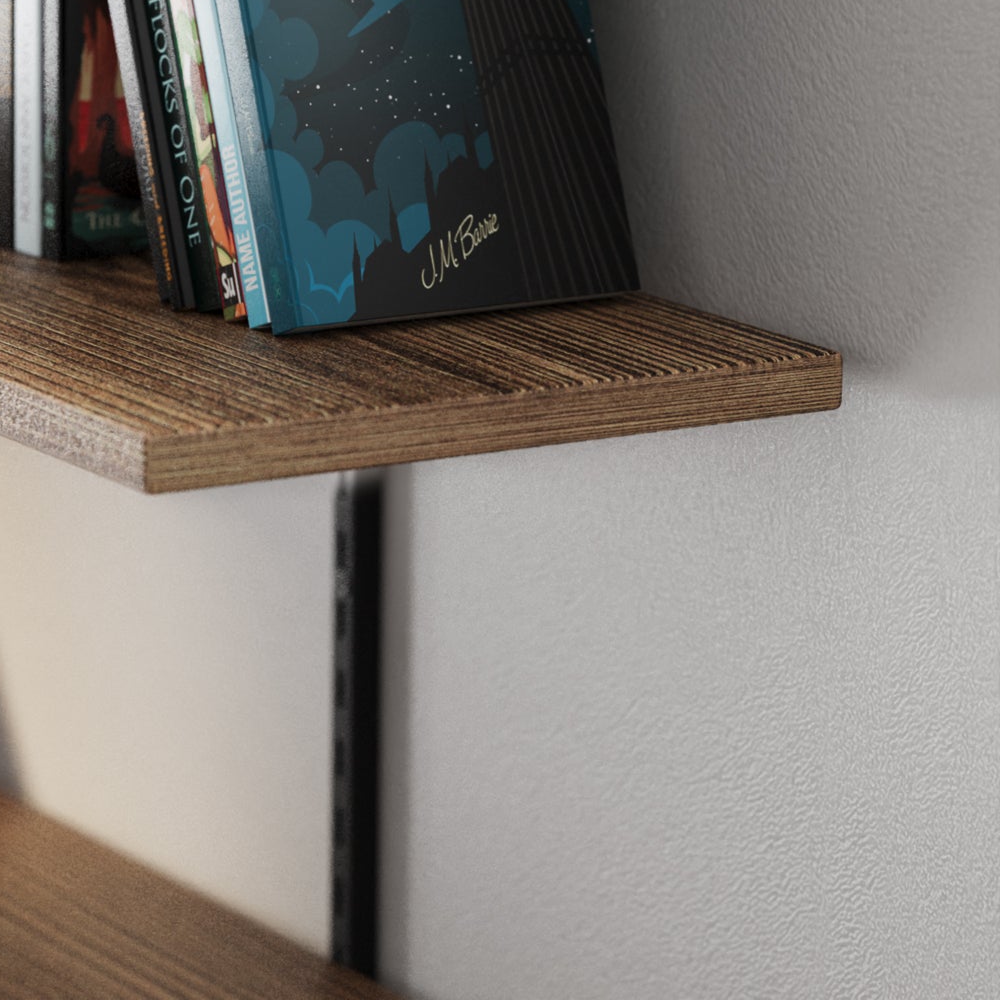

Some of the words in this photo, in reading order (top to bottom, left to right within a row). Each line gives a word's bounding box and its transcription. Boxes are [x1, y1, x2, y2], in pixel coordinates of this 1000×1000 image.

[170, 125, 188, 162] OF
[179, 176, 202, 249] ONE
[220, 144, 247, 225] AUTHOR
[236, 229, 258, 292] NAME
[453, 211, 500, 260] Barrie
